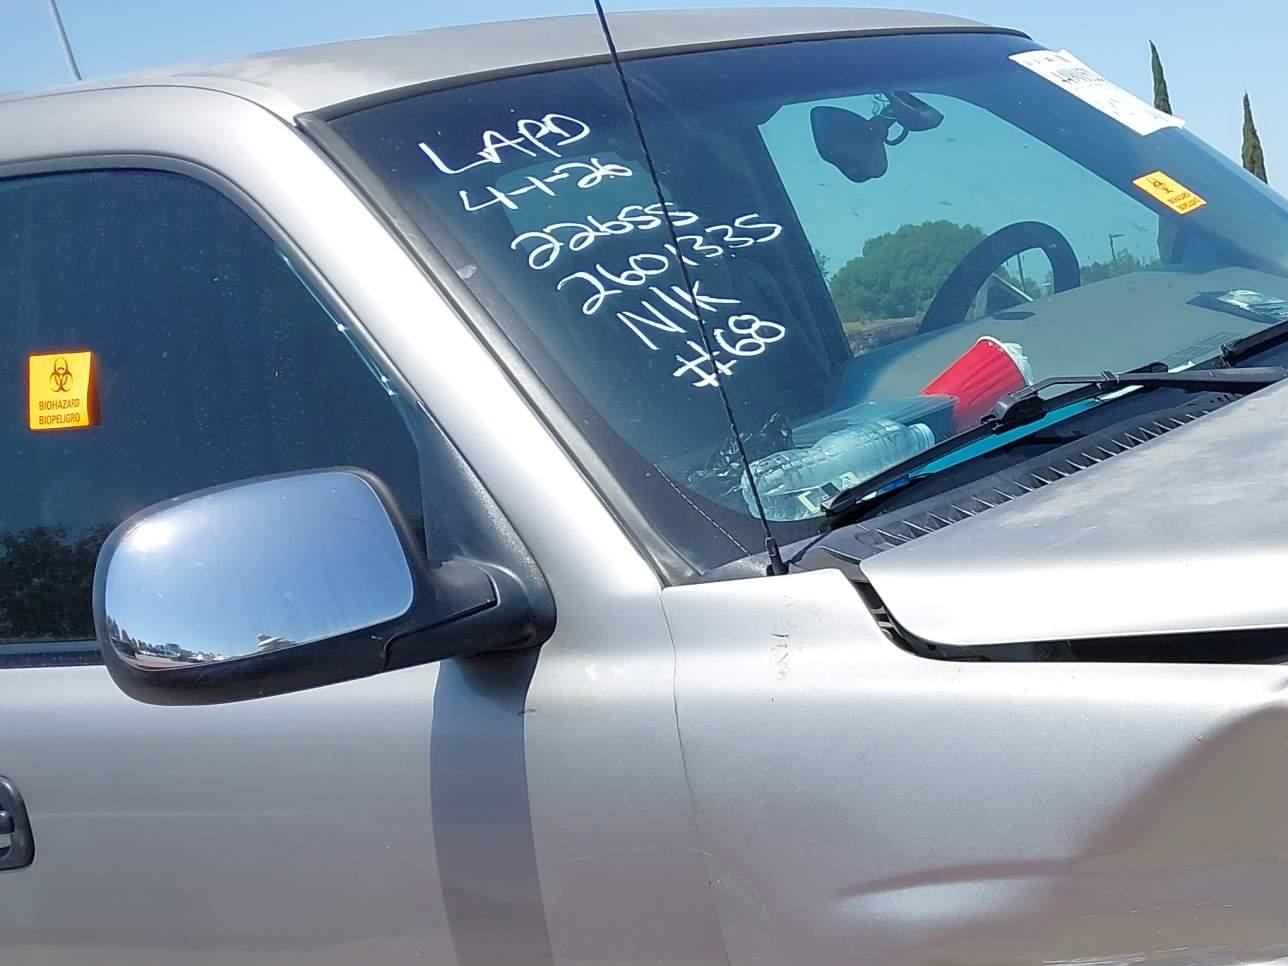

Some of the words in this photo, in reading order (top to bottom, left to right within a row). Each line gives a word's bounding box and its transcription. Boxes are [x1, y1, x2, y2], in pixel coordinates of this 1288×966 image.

[418, 113, 590, 175] LAPD
[458, 157, 633, 212] 4-1-26
[511, 202, 699, 270] 22655
[556, 213, 783, 316] 2601335
[673, 314, 786, 388] #68
[38, 398, 80, 411] BIOHAZARD
[38, 412, 81, 425] BIOPELIGRO
